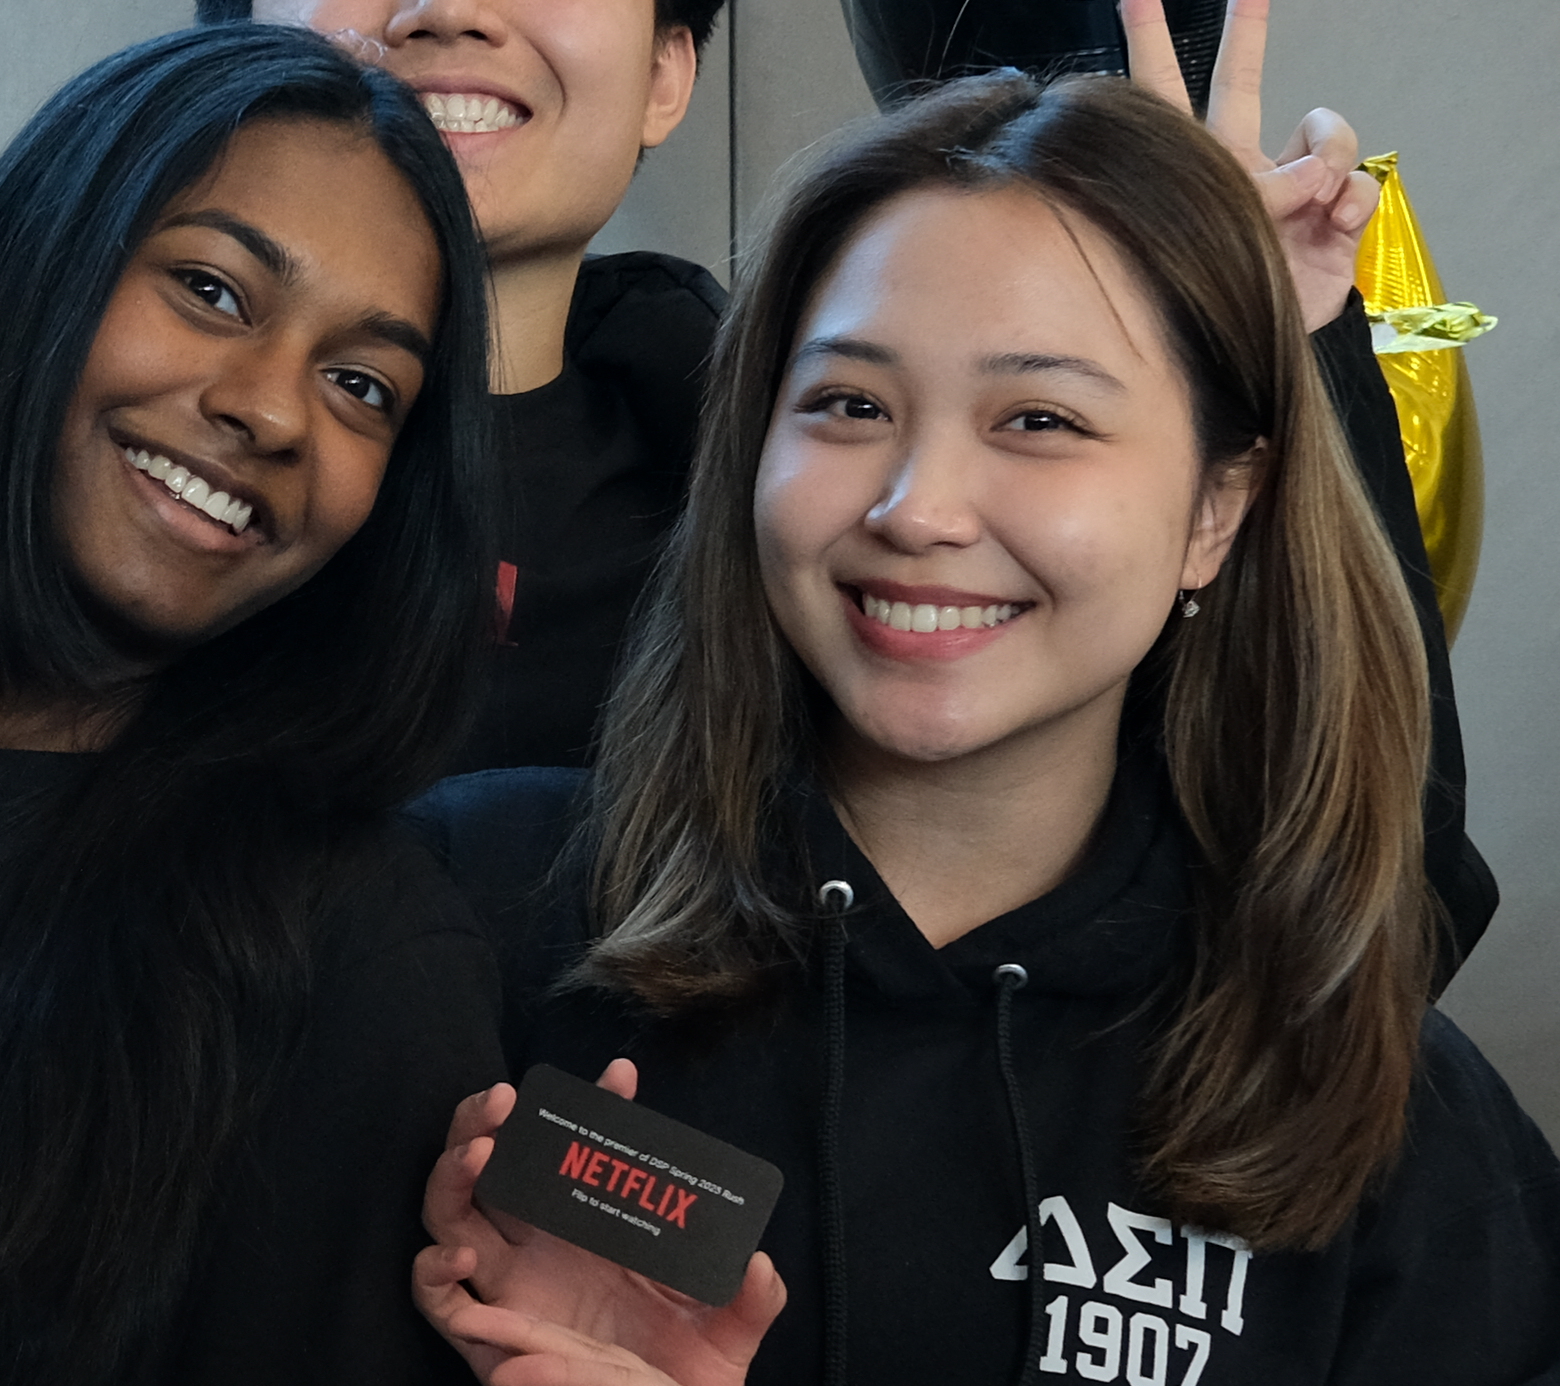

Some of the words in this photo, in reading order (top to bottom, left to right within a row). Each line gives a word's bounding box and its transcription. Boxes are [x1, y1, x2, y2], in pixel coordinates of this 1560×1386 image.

[538, 1107, 578, 1132] Welcome
[578, 1125, 588, 1136] to
[589, 1130, 604, 1143] the
[603, 1137, 639, 1157] premier
[638, 1153, 649, 1162] of
[648, 1156, 670, 1170] DSP
[669, 1166, 699, 1186] Spring
[697, 1178, 722, 1195] 2025
[721, 1190, 746, 1206] Rush
[558, 1140, 699, 1229] NETFLIX
[571, 1188, 587, 1203] Flip
[588, 1195, 600, 1208] to
[599, 1201, 621, 1218] start
[621, 1210, 662, 1237] watching
[989, 1195, 1253, 1336] ΔΣΠ
